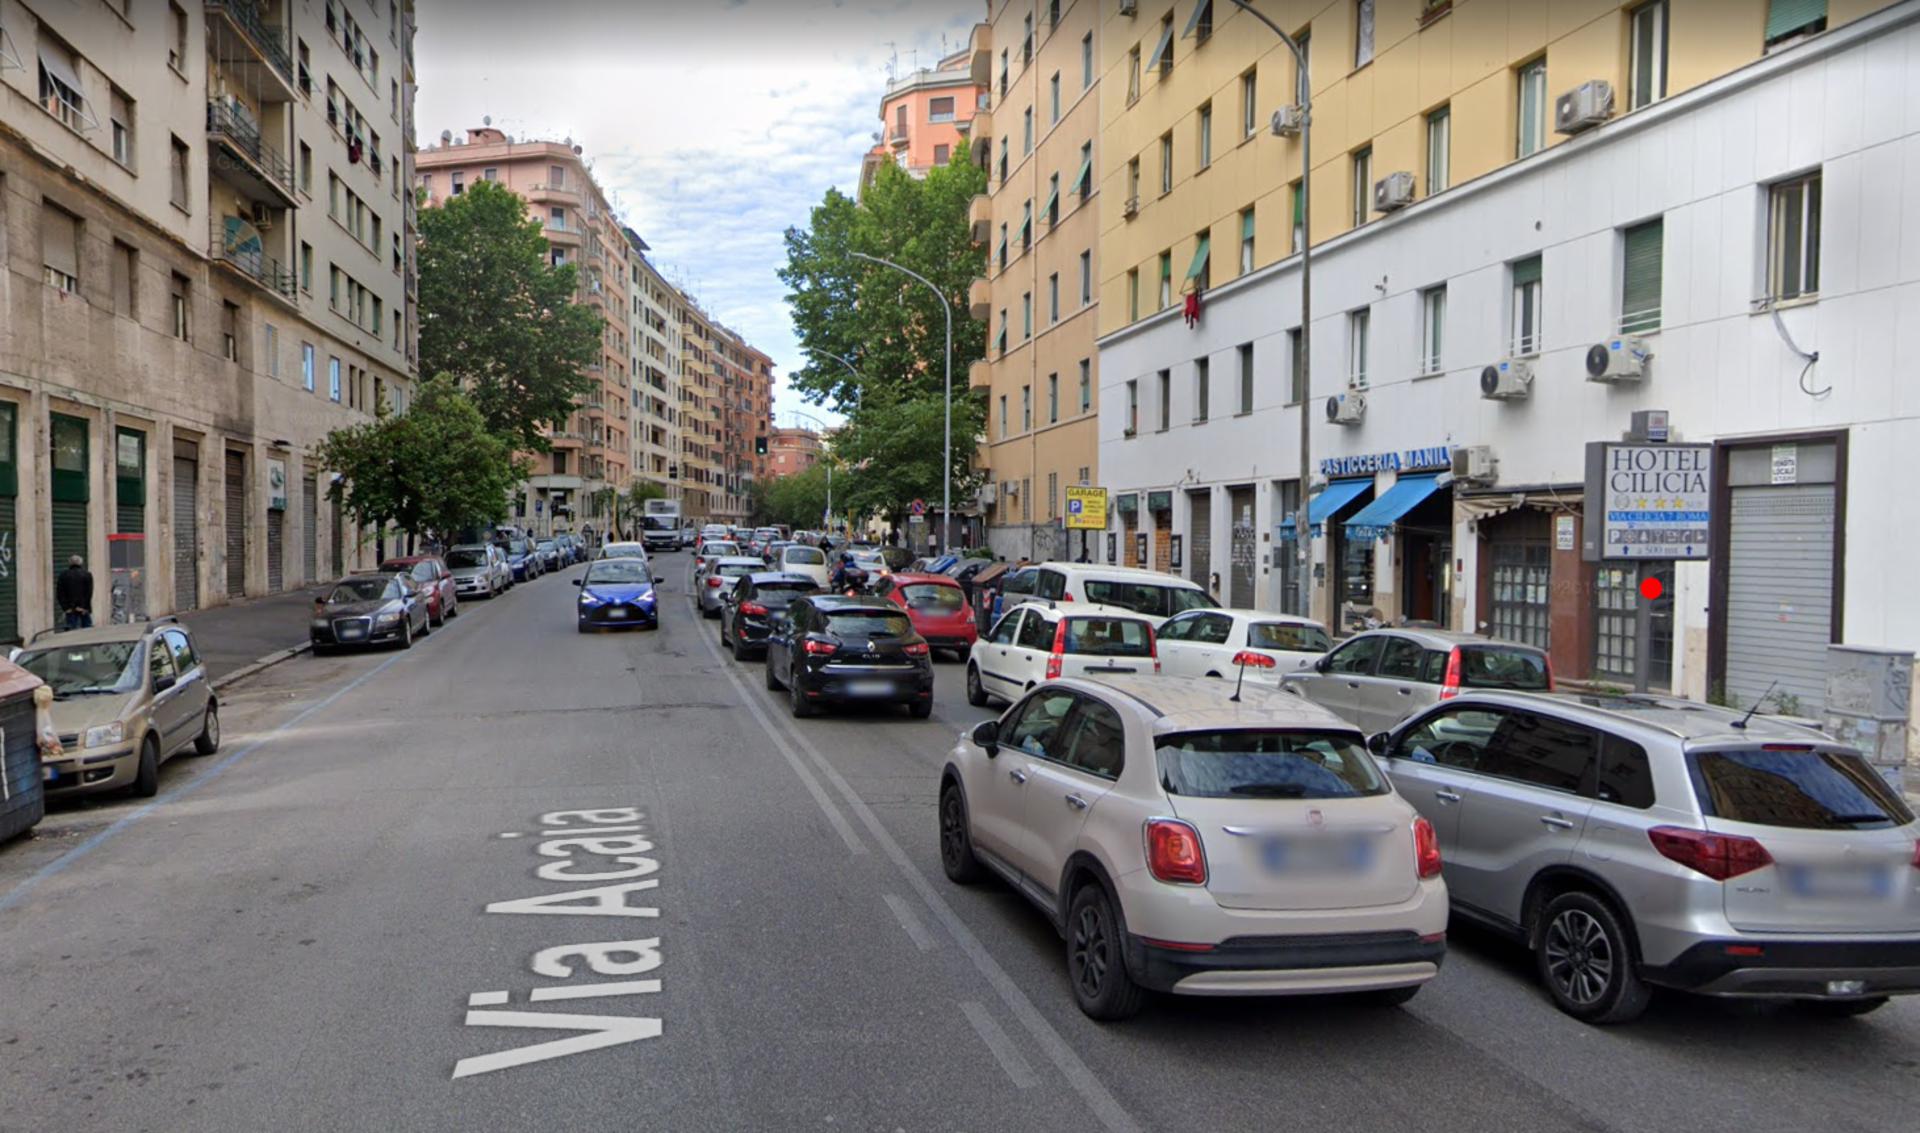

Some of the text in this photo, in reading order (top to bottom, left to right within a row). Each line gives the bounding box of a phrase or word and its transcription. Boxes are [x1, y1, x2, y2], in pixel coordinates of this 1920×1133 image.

[1320, 453, 1400, 475] PASTICCERIA
[1613, 450, 1707, 471] HOTEL
[1611, 472, 1706, 493] CILICIA
[1069, 488, 1104, 497] GARAGE
[1071, 501, 1080, 512] P
[1610, 512, 1626, 520] VIA
[1627, 512, 1665, 520] CILICIA
[1676, 512, 1707, 520] ROMA
[1645, 545, 1663, 553] 500
[452, 807, 663, 1080] Via Acaia
